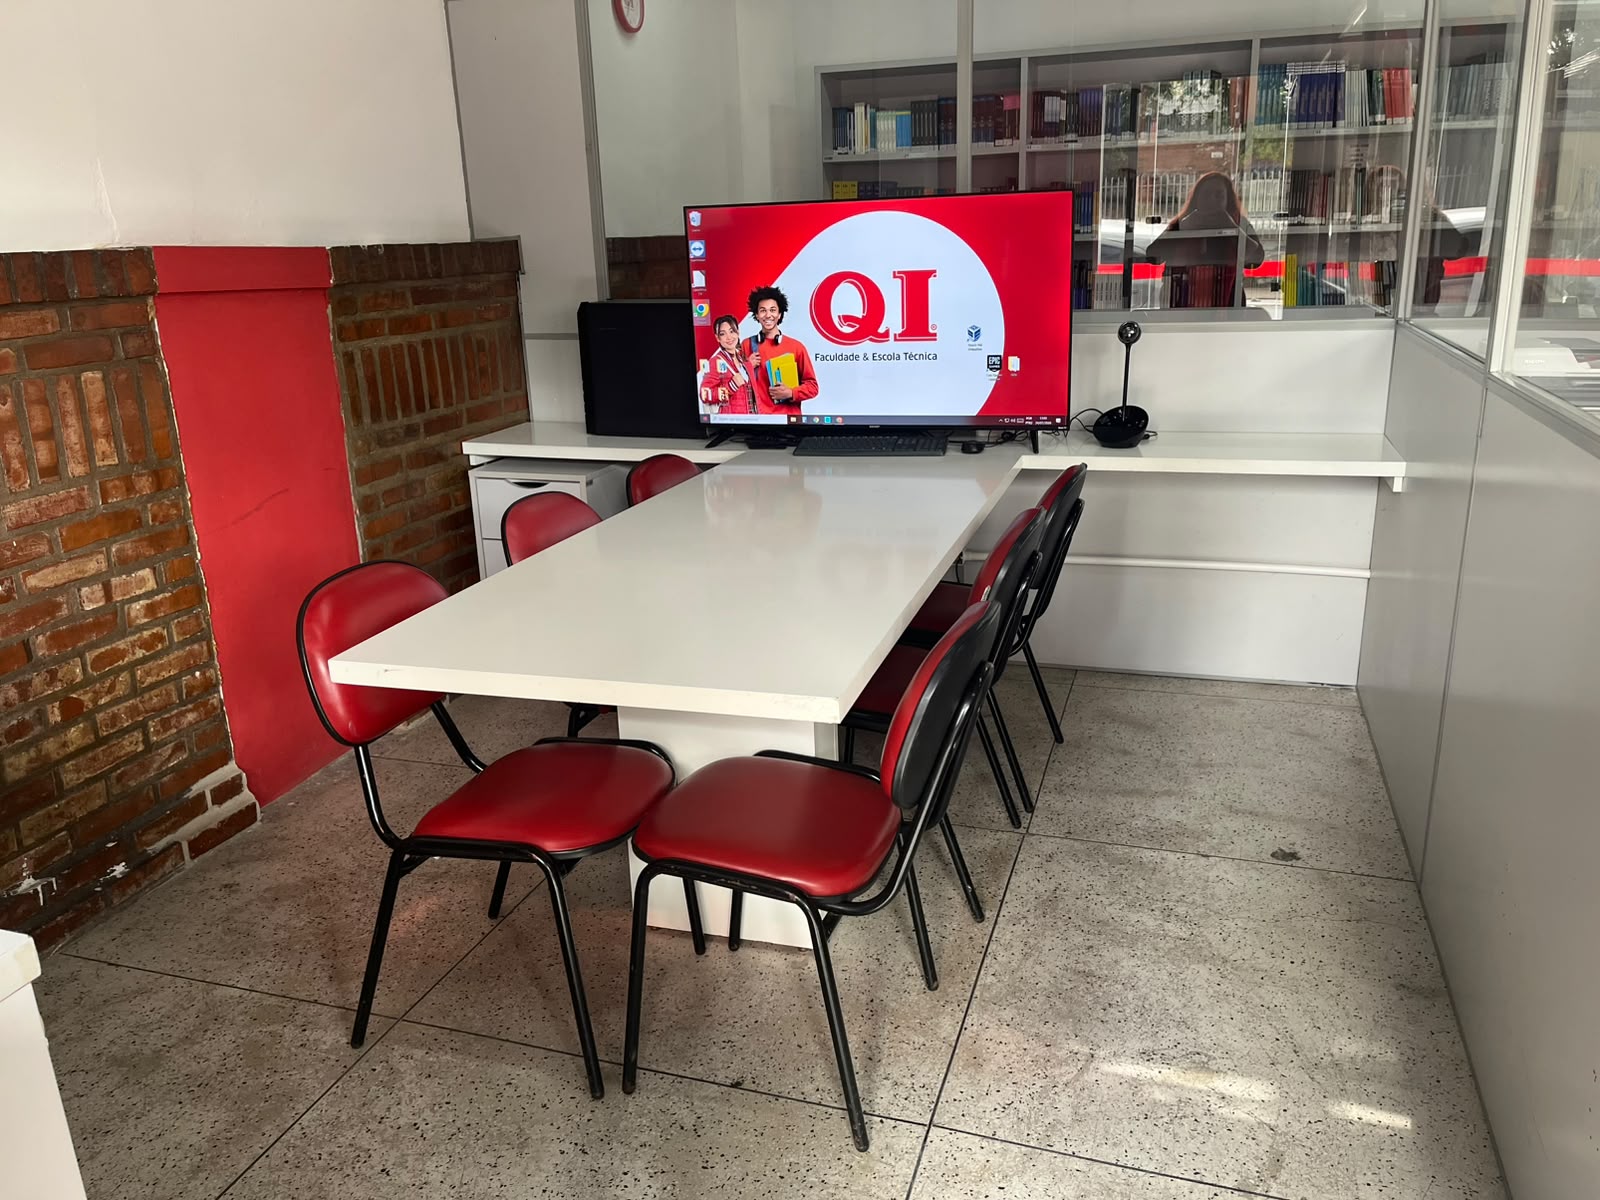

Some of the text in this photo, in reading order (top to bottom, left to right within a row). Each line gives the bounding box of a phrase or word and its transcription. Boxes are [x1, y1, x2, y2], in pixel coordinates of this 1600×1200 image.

[809, 269, 938, 346] QI
[814, 351, 938, 362] Faculdade & Escola Técnica
